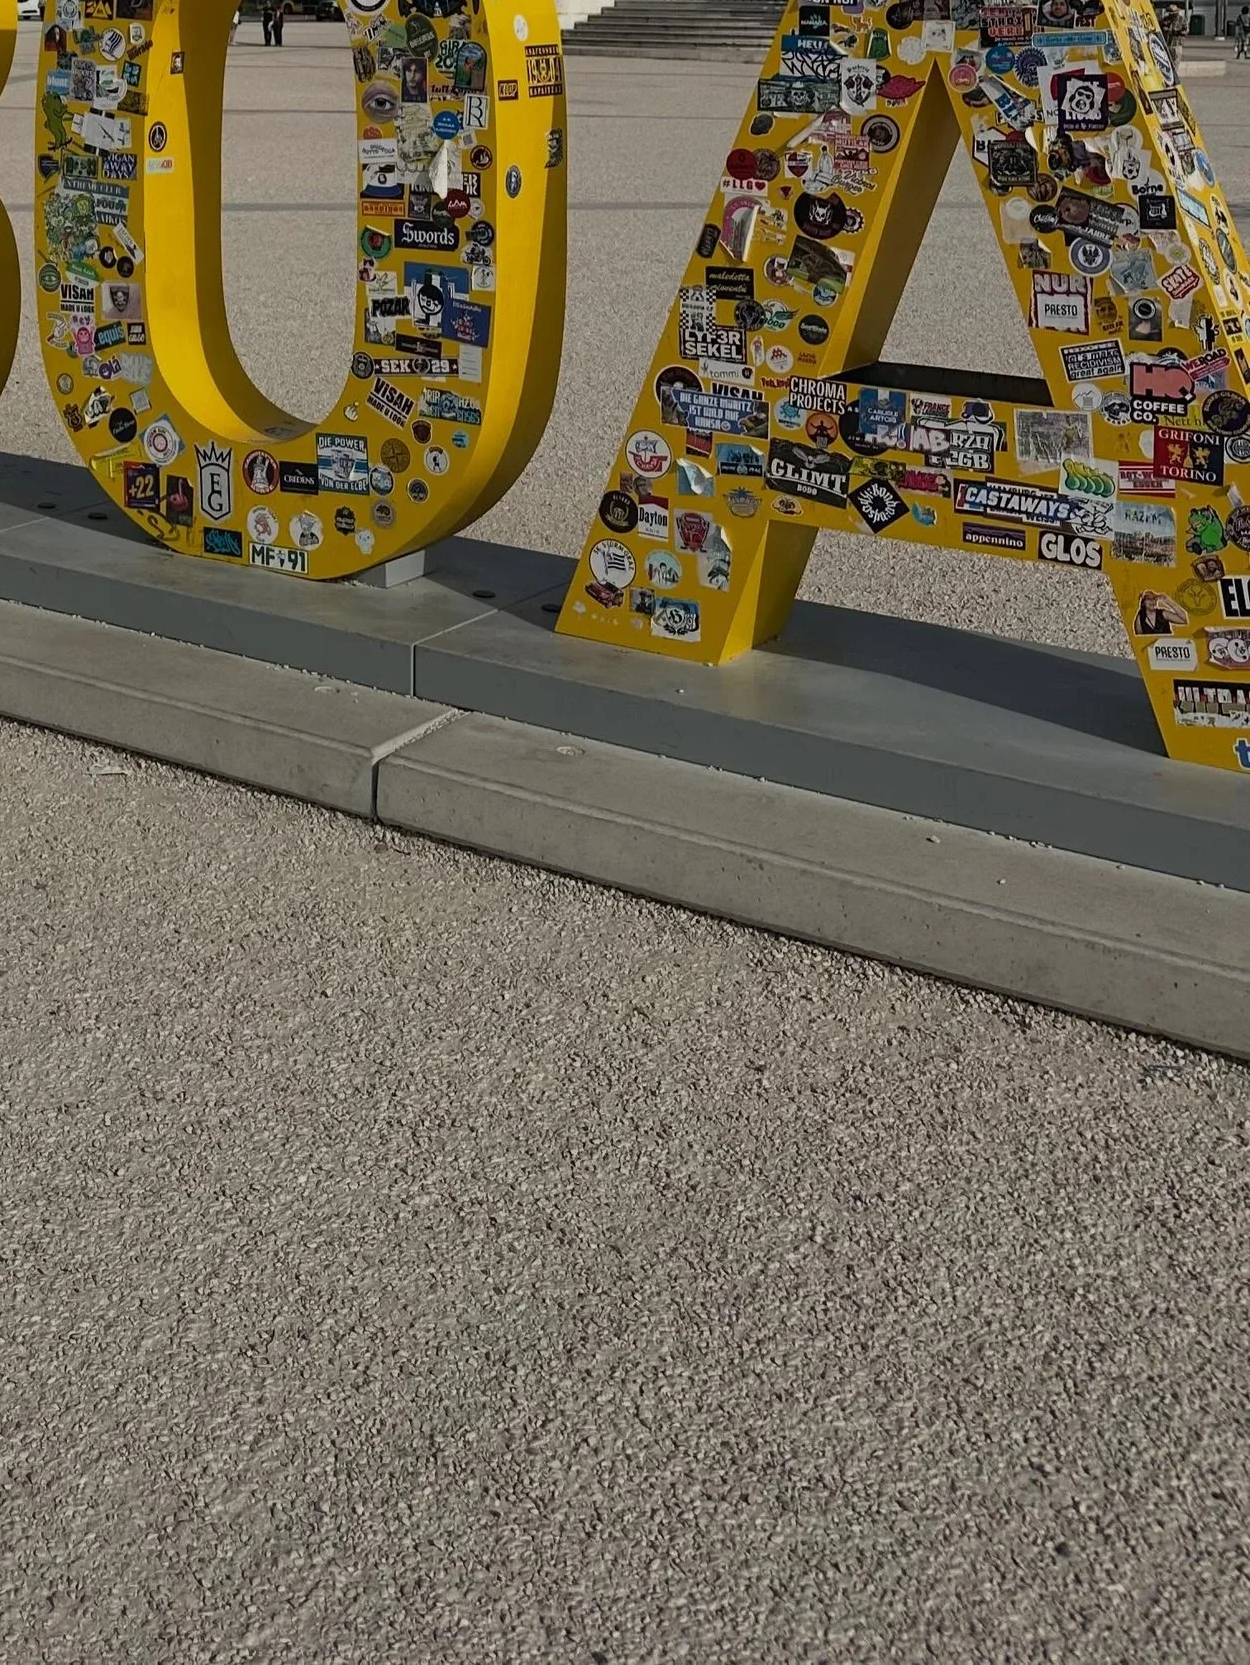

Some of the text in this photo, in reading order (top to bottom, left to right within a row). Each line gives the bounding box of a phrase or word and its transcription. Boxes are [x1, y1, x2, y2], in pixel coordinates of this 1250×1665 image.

[1131, 183, 1164, 194] Borne
[401, 222, 456, 246] Swords
[1044, 303, 1079, 317] PRESTO
[97, 323, 125, 346] equis
[685, 329, 742, 346] LYF3R
[684, 341, 743, 360] SEKEL
[381, 359, 450, 373] SEK 29
[1183, 348, 1228, 372] WEROAD
[1070, 365, 1096, 379] great
[1132, 364, 1192, 398] HQ
[679, 391, 695, 404] DIE
[790, 377, 846, 401] CHROMA
[366, 395, 385, 413] MADE
[790, 391, 846, 416] PROJECTS
[1132, 399, 1186, 415] COFFEE
[1132, 410, 1157, 423] CO.
[1163, 415, 1192, 427] Nett
[317, 436, 367, 452] DIE POWER
[1158, 428, 1221, 446] GRIFONI
[770, 459, 847, 493] GLIMT
[1159, 465, 1217, 483] TORINO
[207, 490, 224, 512] G
[965, 484, 1071, 518] CASTAWAYS
[638, 505, 669, 528] Dayton
[965, 531, 1025, 548] appennino
[251, 544, 307, 572] MF 91
[1040, 532, 1102, 567] GLOS
[1221, 577, 1250, 618] EL
[1155, 646, 1191, 660] PRESTO
